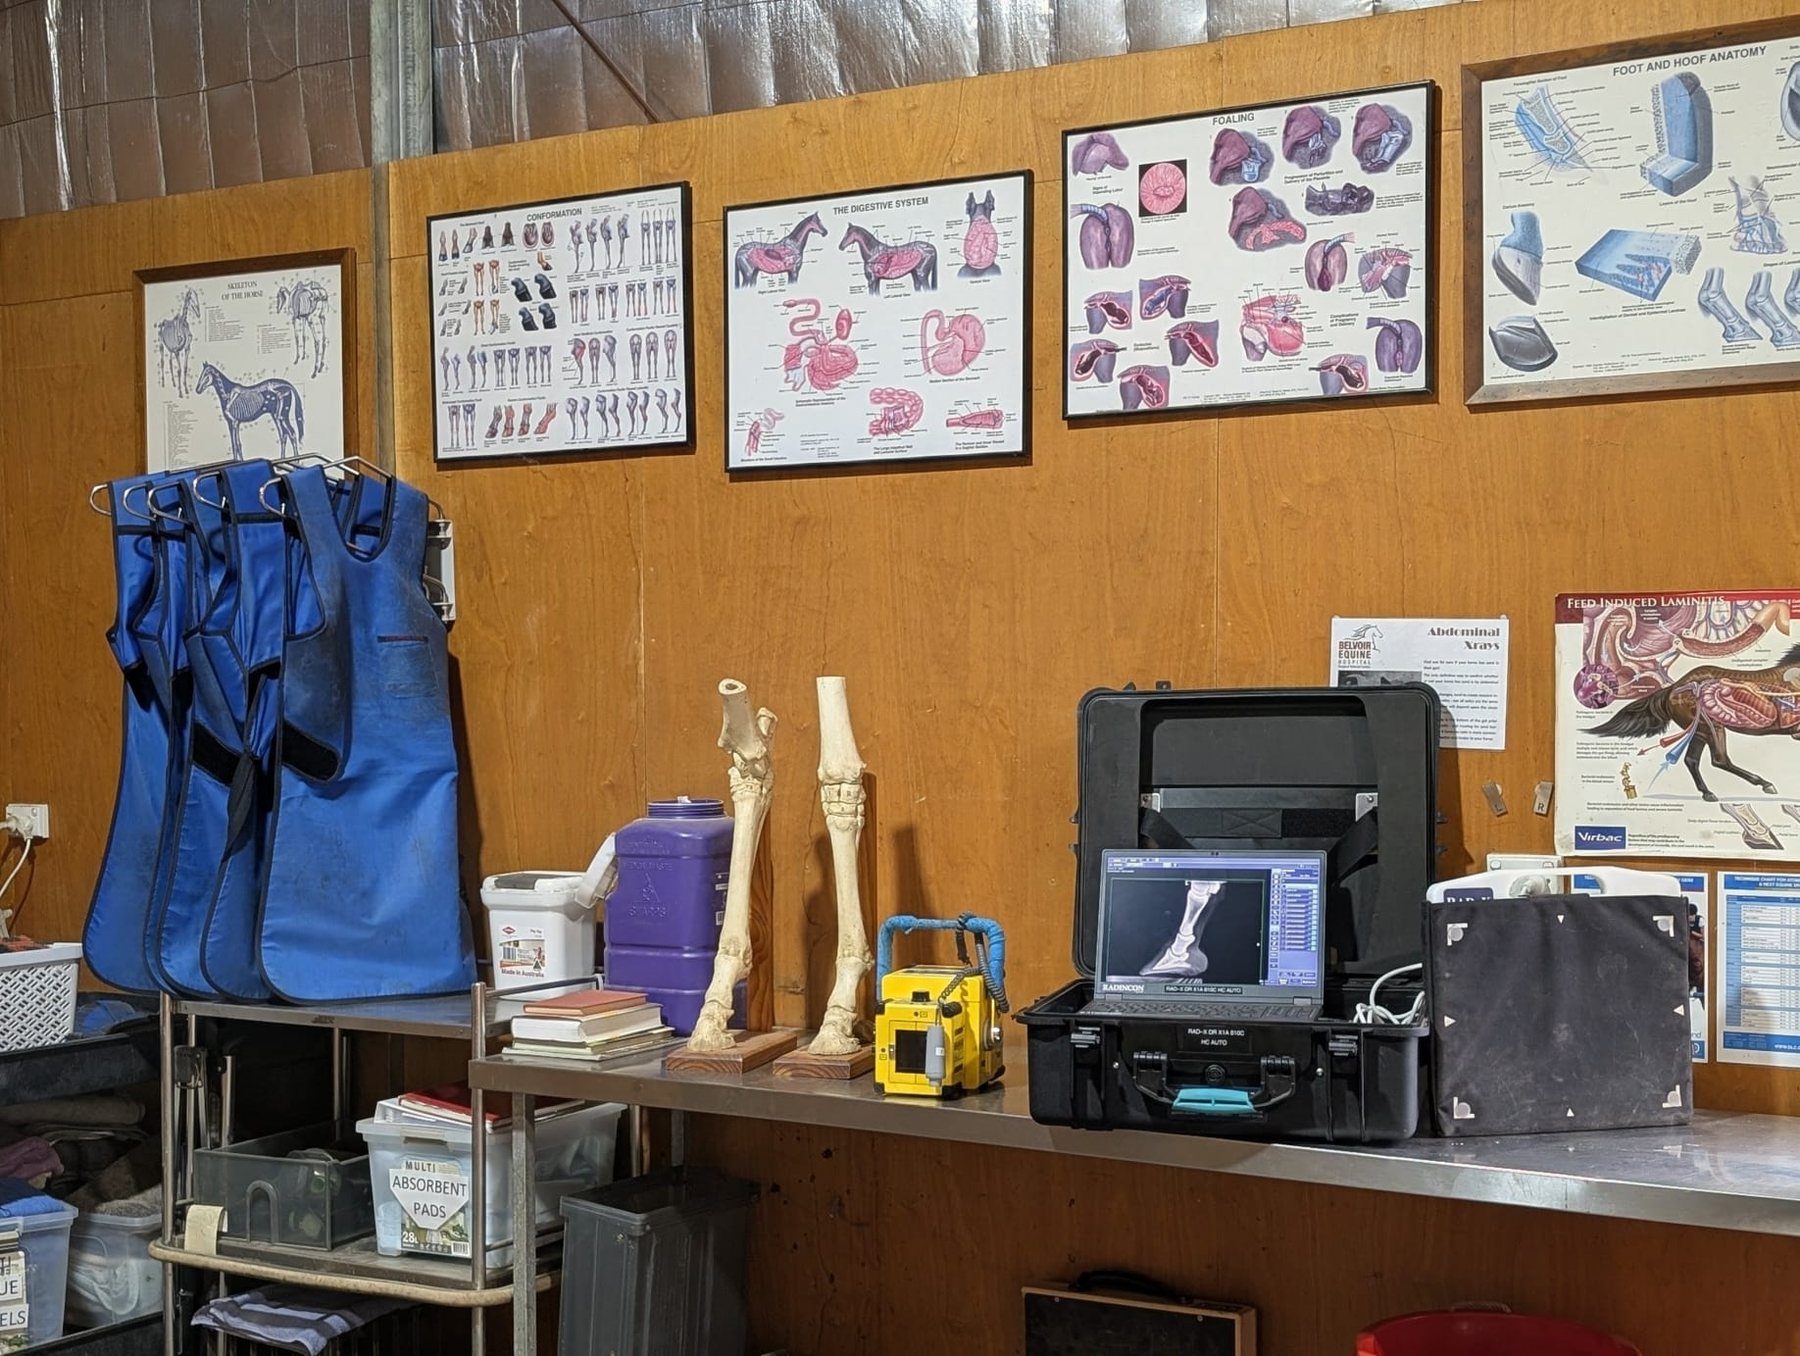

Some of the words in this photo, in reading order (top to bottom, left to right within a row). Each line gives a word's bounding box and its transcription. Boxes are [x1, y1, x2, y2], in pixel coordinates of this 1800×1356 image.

[1613, 64, 1644, 76] FOOT
[1646, 60, 1670, 72] AND
[1674, 54, 1707, 67] HOOF
[1709, 46, 1767, 63] ANATOMY
[1212, 112, 1254, 126] FOALING
[833, 206, 848, 215] THE
[851, 201, 893, 213] DIGESTIVE
[895, 197, 929, 208] SYSTEM
[527, 208, 582, 222] CONFORMATION
[228, 281, 257, 289] SKELETON
[1567, 598, 1596, 609] FEED
[1600, 597, 1656, 608] INDUCED
[1661, 595, 1725, 607] LAMINITIS
[1428, 627, 1500, 637] Abdominal
[1338, 641, 1371, 650] BELVOIR
[1464, 640, 1500, 650] Xrays
[1338, 651, 1371, 659] EQUINE
[1538, 802, 1544, 811] R
[1578, 832, 1622, 842] Virbac
[1102, 984, 1144, 992] RADINCON
[405, 1161, 436, 1173] MULTI
[392, 1176, 467, 1197] ABSORBENT
[414, 1202, 446, 1218] PADS
